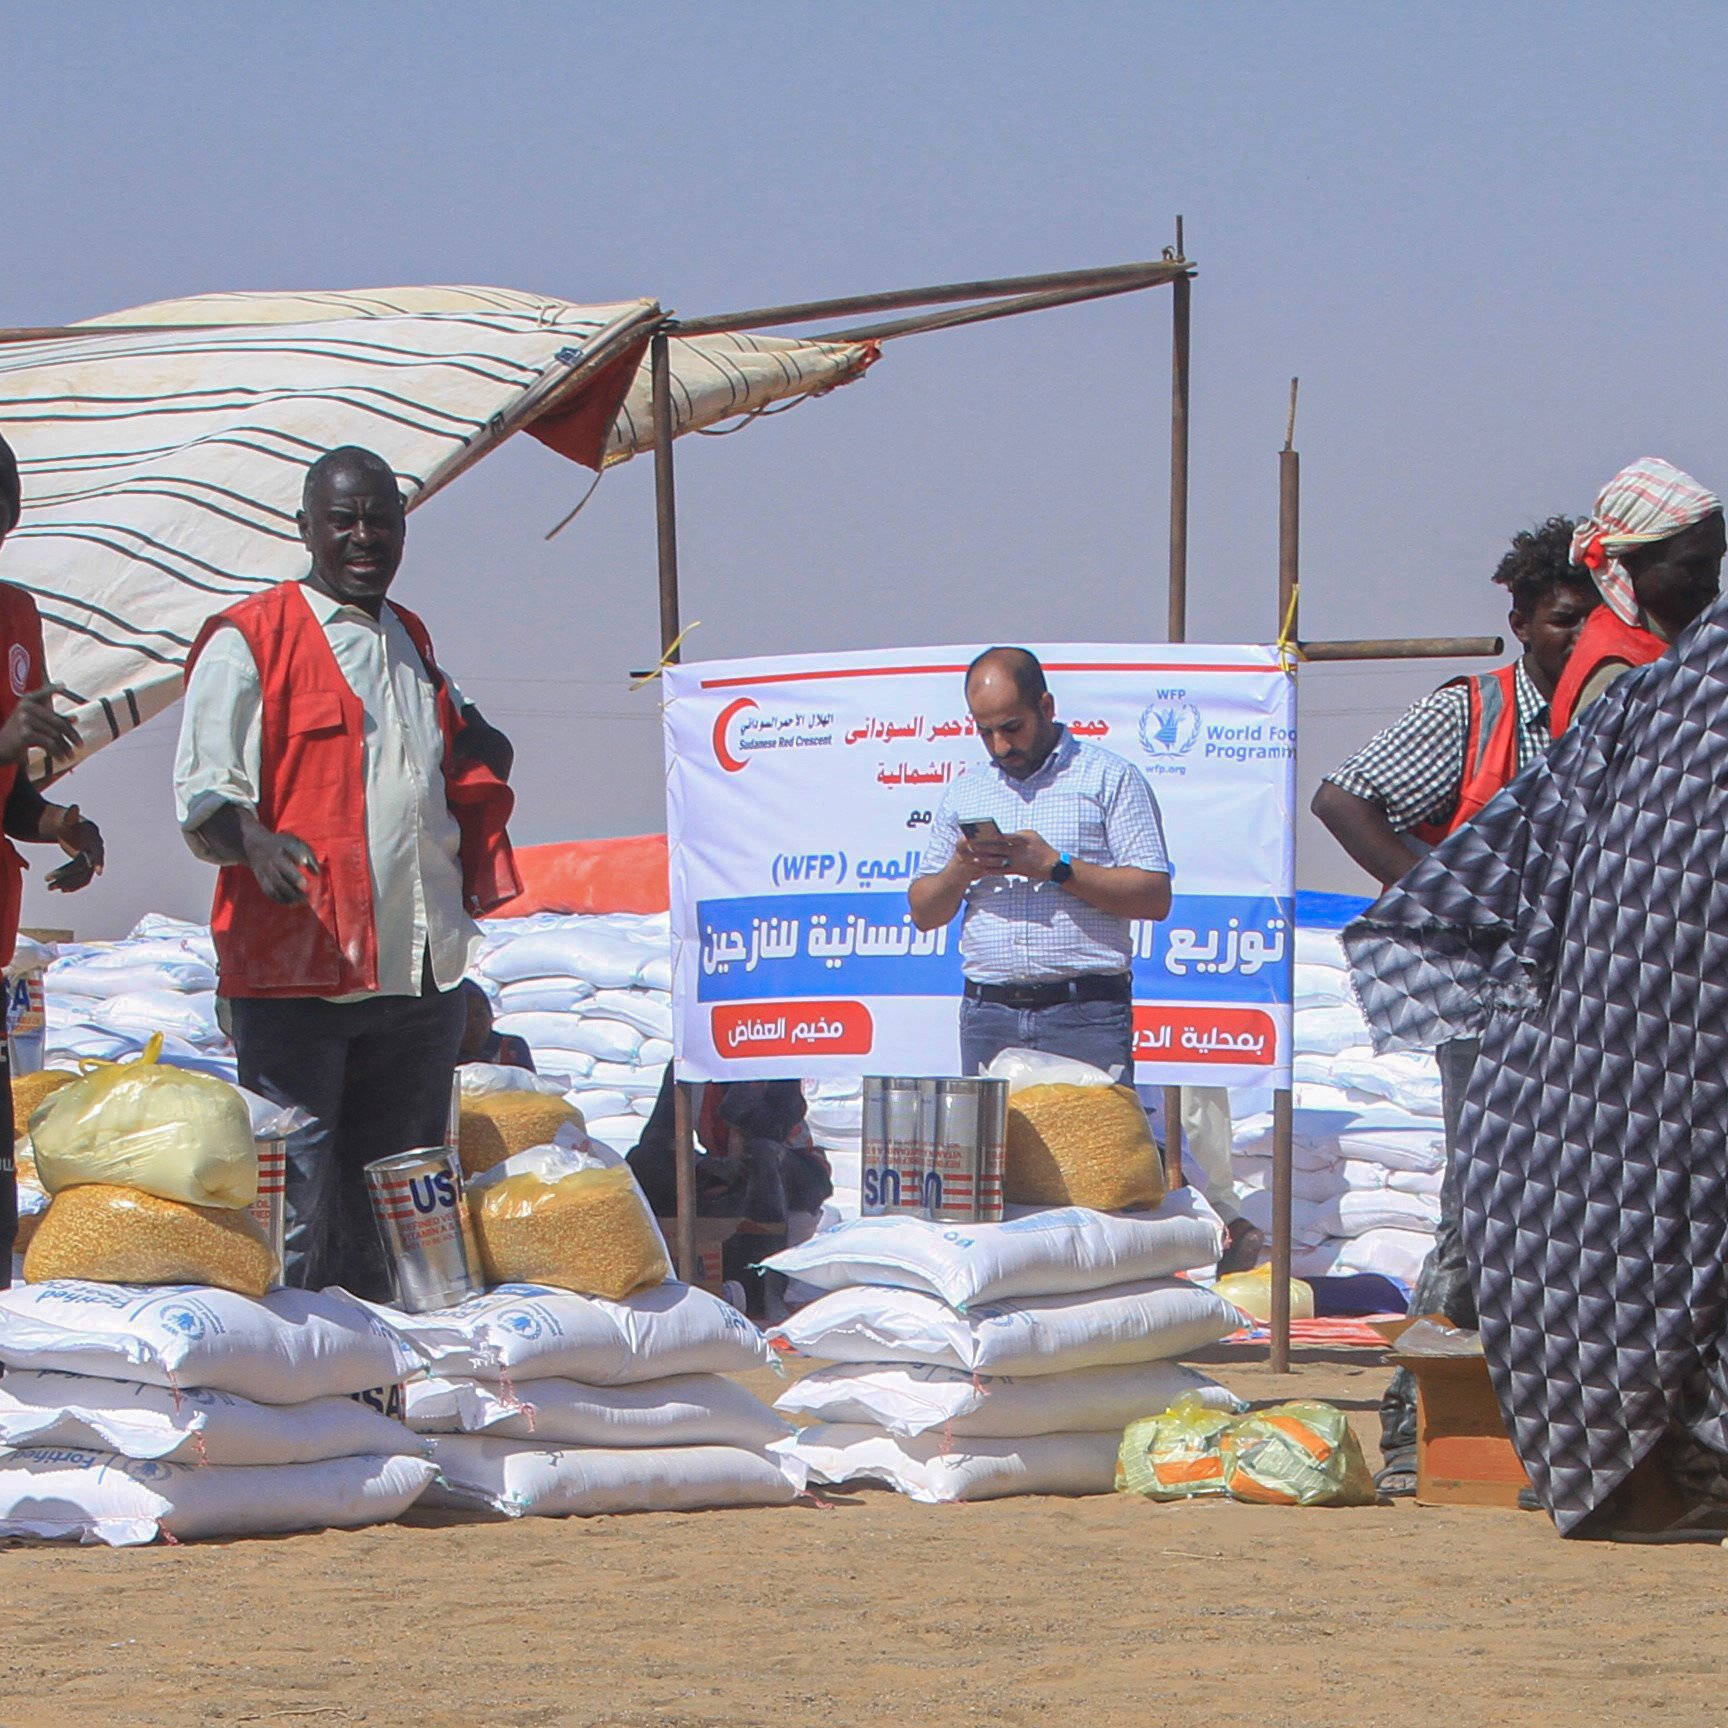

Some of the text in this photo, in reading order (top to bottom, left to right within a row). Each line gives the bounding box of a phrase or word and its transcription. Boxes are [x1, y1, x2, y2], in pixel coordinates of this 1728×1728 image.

[1156, 689, 1186, 700] WFP
[739, 734, 833, 751] Sudanese Red Crescent
[1067, 719, 1110, 740] جمع
[1207, 726, 1297, 741] World Foo
[1205, 743, 1297, 762] Programm
[876, 760, 952, 790] الشمالية
[1145, 765, 1186, 776] wfp.org
[906, 808, 933, 829] مع
[771, 850, 848, 887] (WFP)
[702, 917, 800, 976] للنازحين
[1165, 917, 1286, 976] توزيع
[790, 1017, 844, 1044] مخيم
[1132, 1025, 1265, 1056] بمحلية الدب
[409, 1169, 457, 1214] US
[863, 1168, 900, 1206] US
